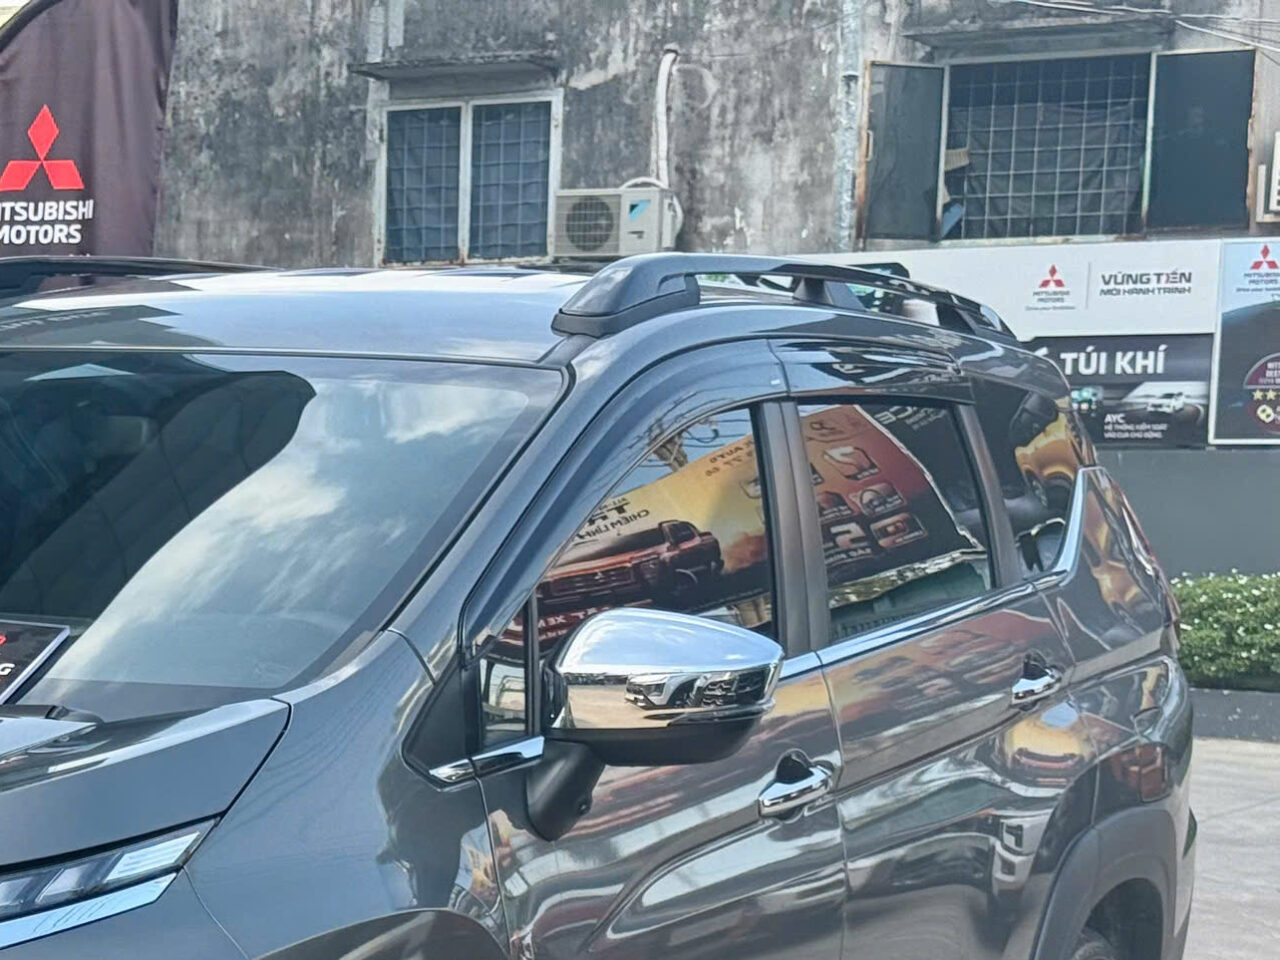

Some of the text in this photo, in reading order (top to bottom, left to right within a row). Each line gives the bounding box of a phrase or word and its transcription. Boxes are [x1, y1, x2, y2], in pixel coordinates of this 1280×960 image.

[1060, 344, 1168, 375] TÚI KHÍ
[1104, 413, 1125, 424] AYC
